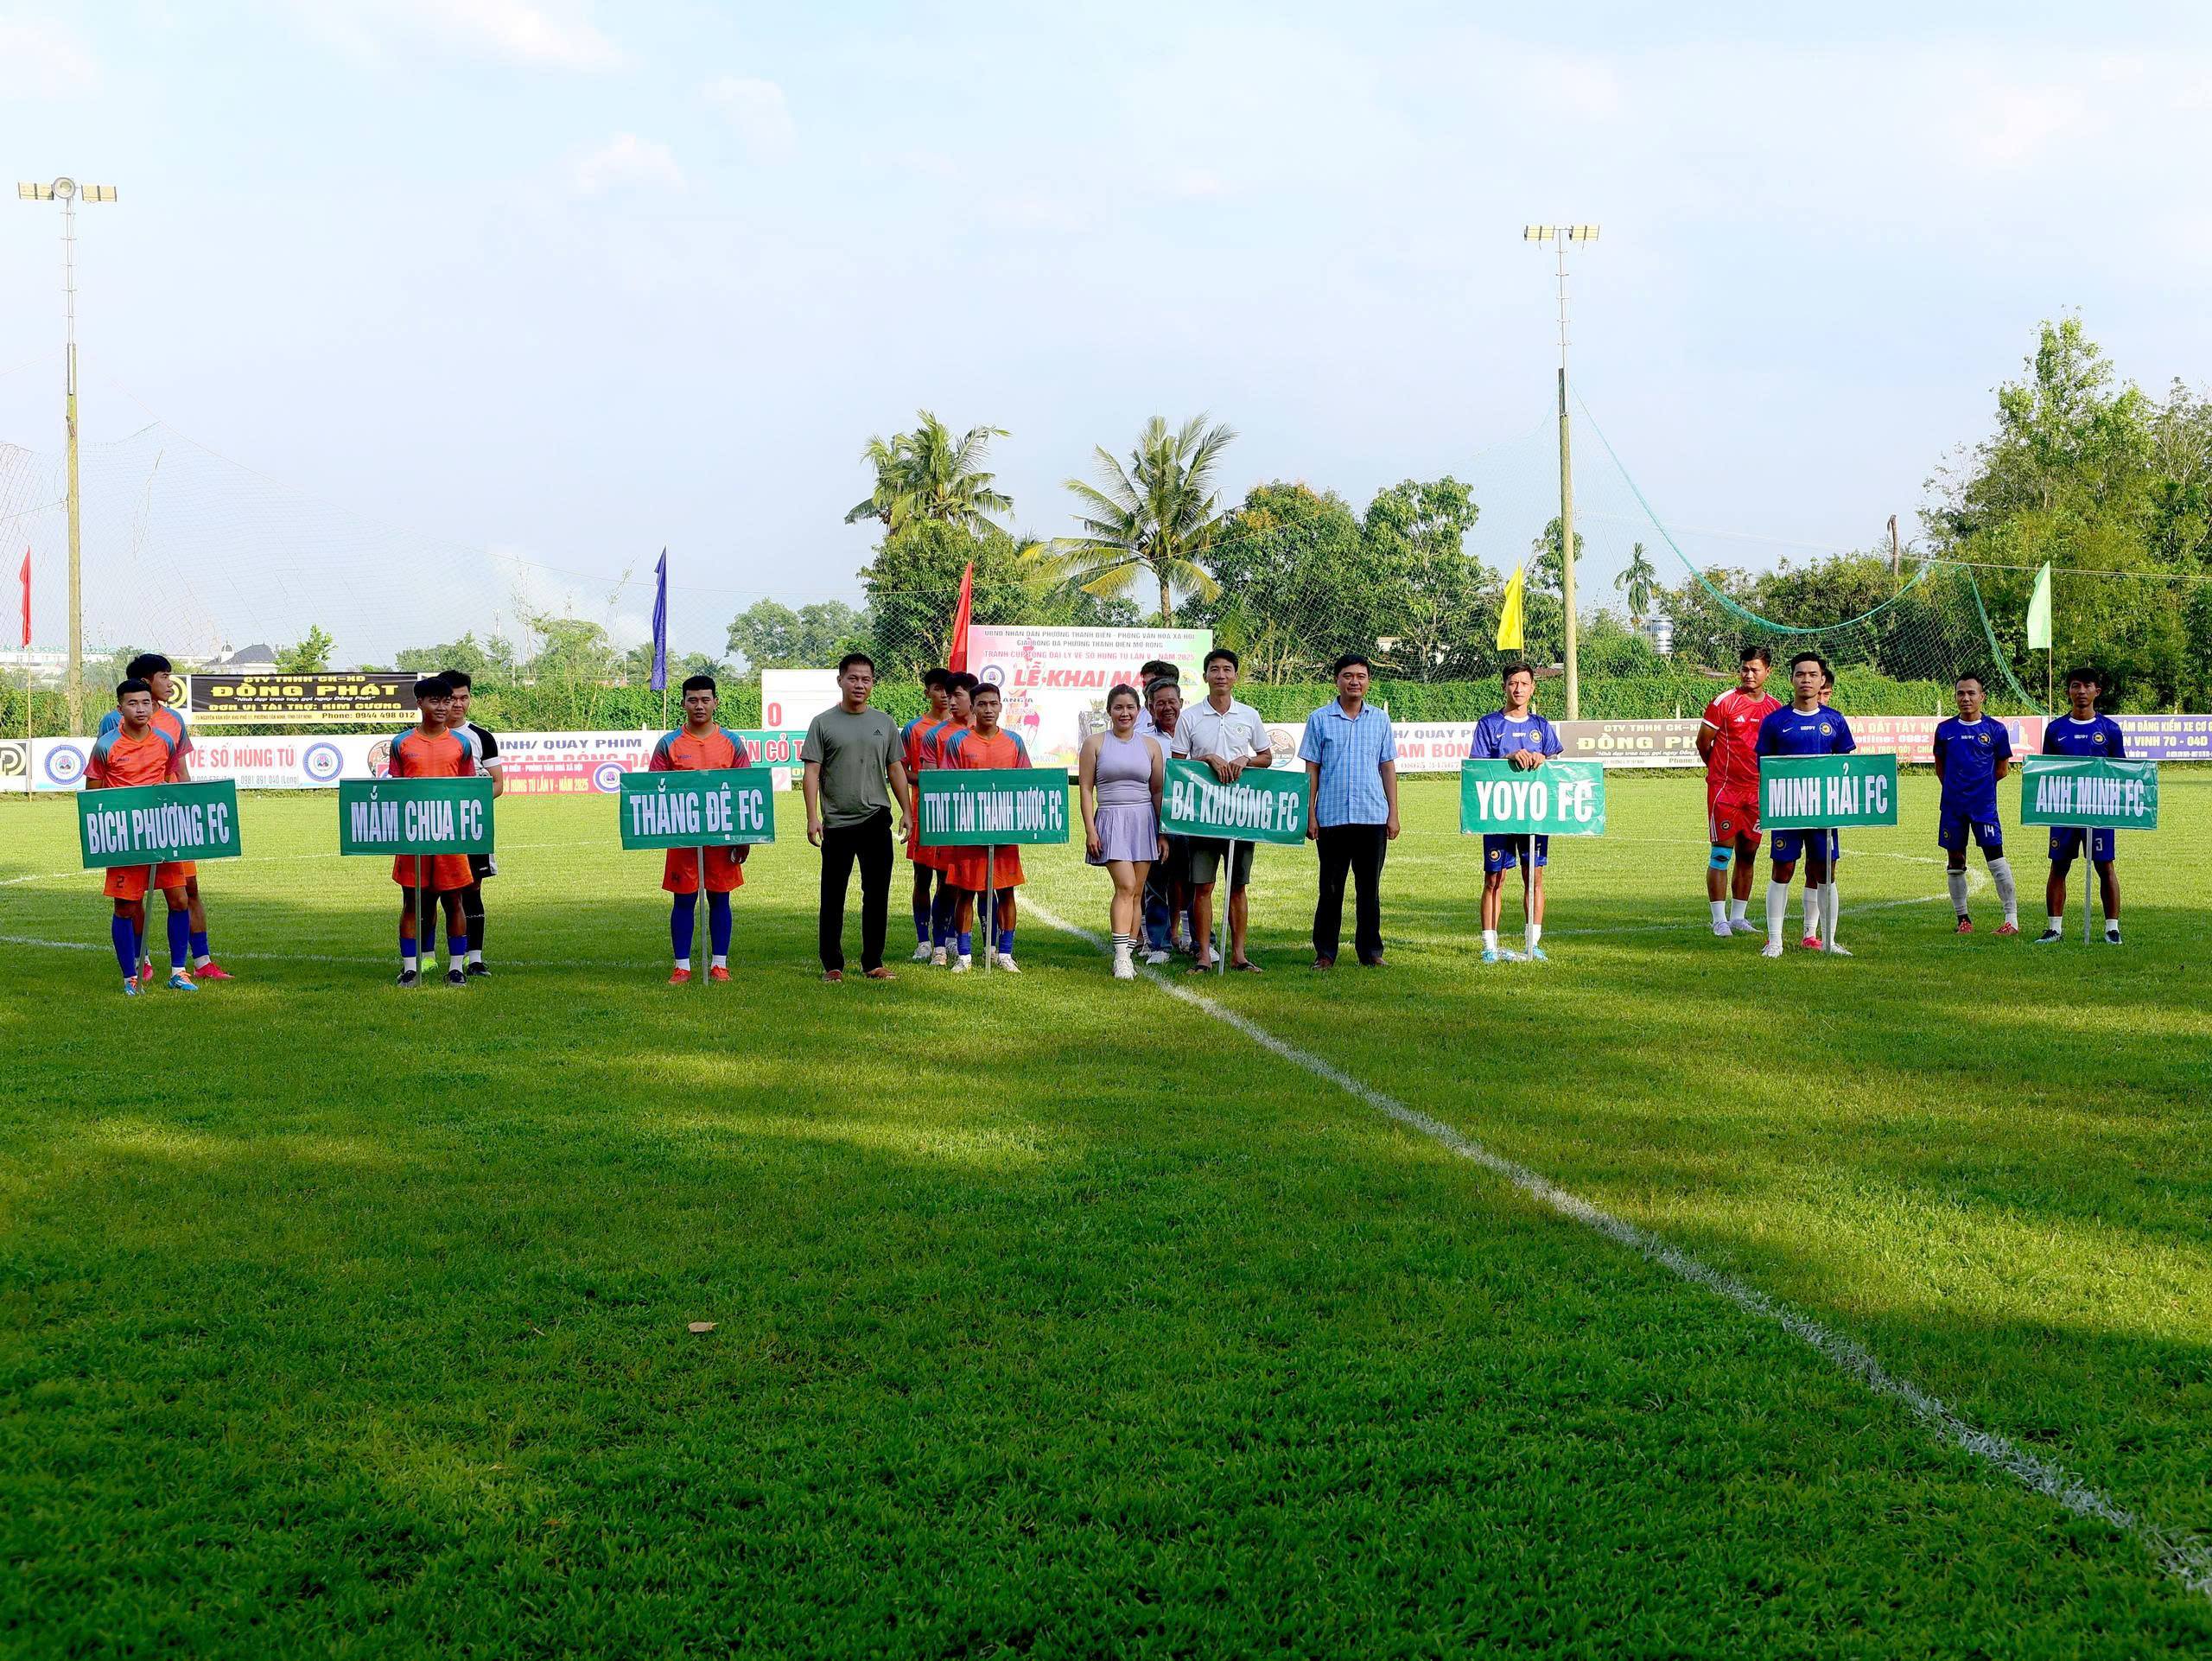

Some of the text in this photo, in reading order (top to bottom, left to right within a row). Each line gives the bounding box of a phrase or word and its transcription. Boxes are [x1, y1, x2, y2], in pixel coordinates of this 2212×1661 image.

[211, 683, 398, 697] ĐỒNG PHÁT
[1046, 670, 1105, 687] KHAI
[767, 703, 782, 727] 0
[2183, 721, 2194, 732] XE
[543, 740, 588, 751] QUAY
[596, 739, 642, 748] PHIM
[1414, 729, 1455, 739] QUAY
[1576, 733, 1698, 750] ĐỒNG PH
[2134, 735, 2160, 747] VINH
[2163, 735, 2177, 747] 70
[765, 733, 790, 762] CỎ
[1431, 741, 1469, 758] BÓN
[1475, 780, 1593, 822] YOYO FC
[1768, 761, 1888, 818] MINH HẢI FC
[2035, 774, 2145, 818] ANH MINH FC
[739, 789, 763, 830] FC
[924, 782, 1063, 840] TTNT TÂN THÀNH ĐƯỢC FC
[1199, 783, 1274, 830] KHƯƠNG
[1277, 792, 1299, 832] FC
[86, 800, 230, 857] BÍCH PHƯỢNG FC
[404, 799, 455, 842] CHUA
[461, 799, 483, 842] FC
[1984, 824, 1994, 837] 14
